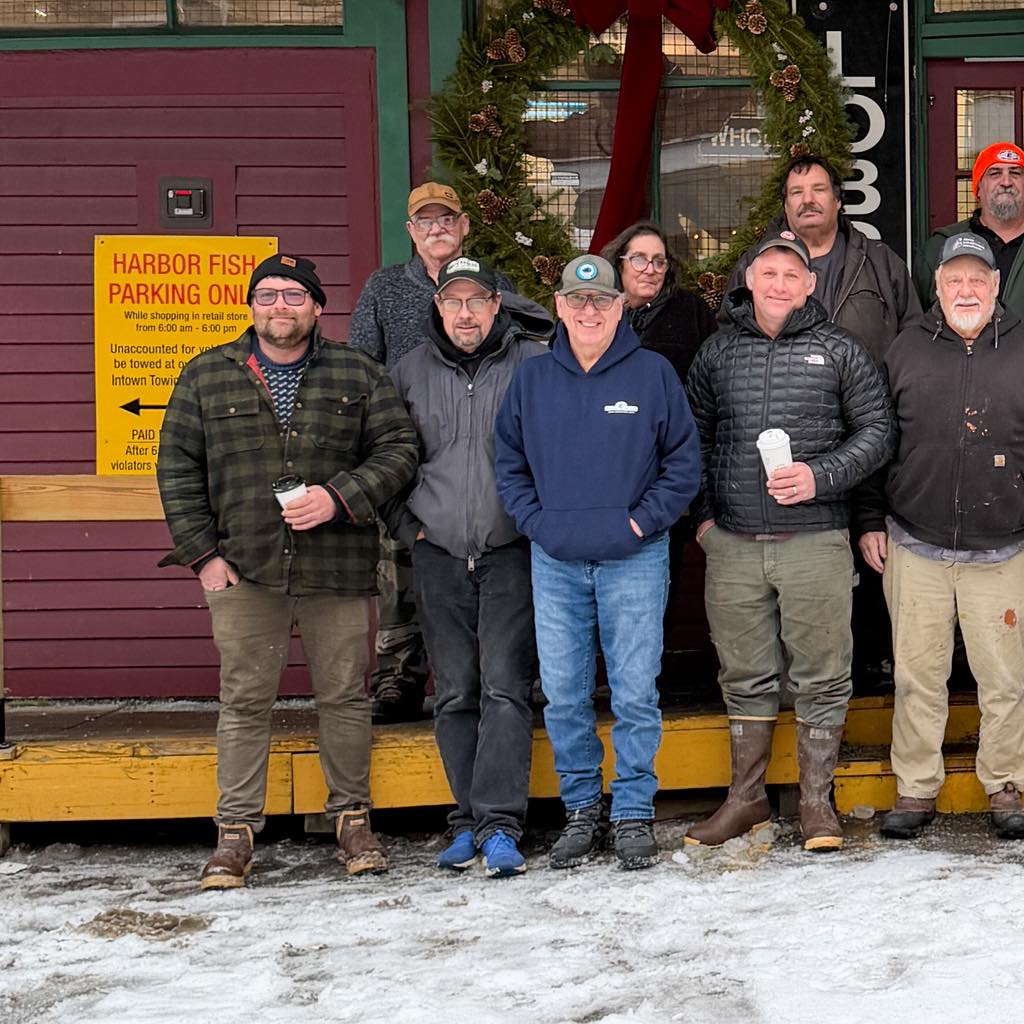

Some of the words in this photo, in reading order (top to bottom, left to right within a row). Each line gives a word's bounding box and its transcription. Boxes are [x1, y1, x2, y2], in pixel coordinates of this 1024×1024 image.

[113, 253, 201, 275] HARBOR
[209, 254, 256, 275] FISH
[109, 283, 201, 305] PARKING
[208, 284, 248, 305] ONL
[124, 311, 148, 320] While
[150, 311, 190, 321] shopping
[191, 311, 200, 320] in
[202, 312, 224, 321] retail
[226, 313, 248, 321] store
[136, 323, 156, 332] from
[158, 324, 177, 332] 6:00
[202, 324, 221, 333] 6:00
[223, 325, 237, 334] pm
[110, 343, 178, 354] Unaccounted
[181, 344, 196, 354] for
[114, 359, 127, 369] be
[130, 359, 162, 369] towed
[165, 359, 176, 369] at
[112, 374, 147, 386] Intown
[131, 429, 155, 440] PAID
[125, 445, 149, 456] After
[111, 460, 152, 471] violators
